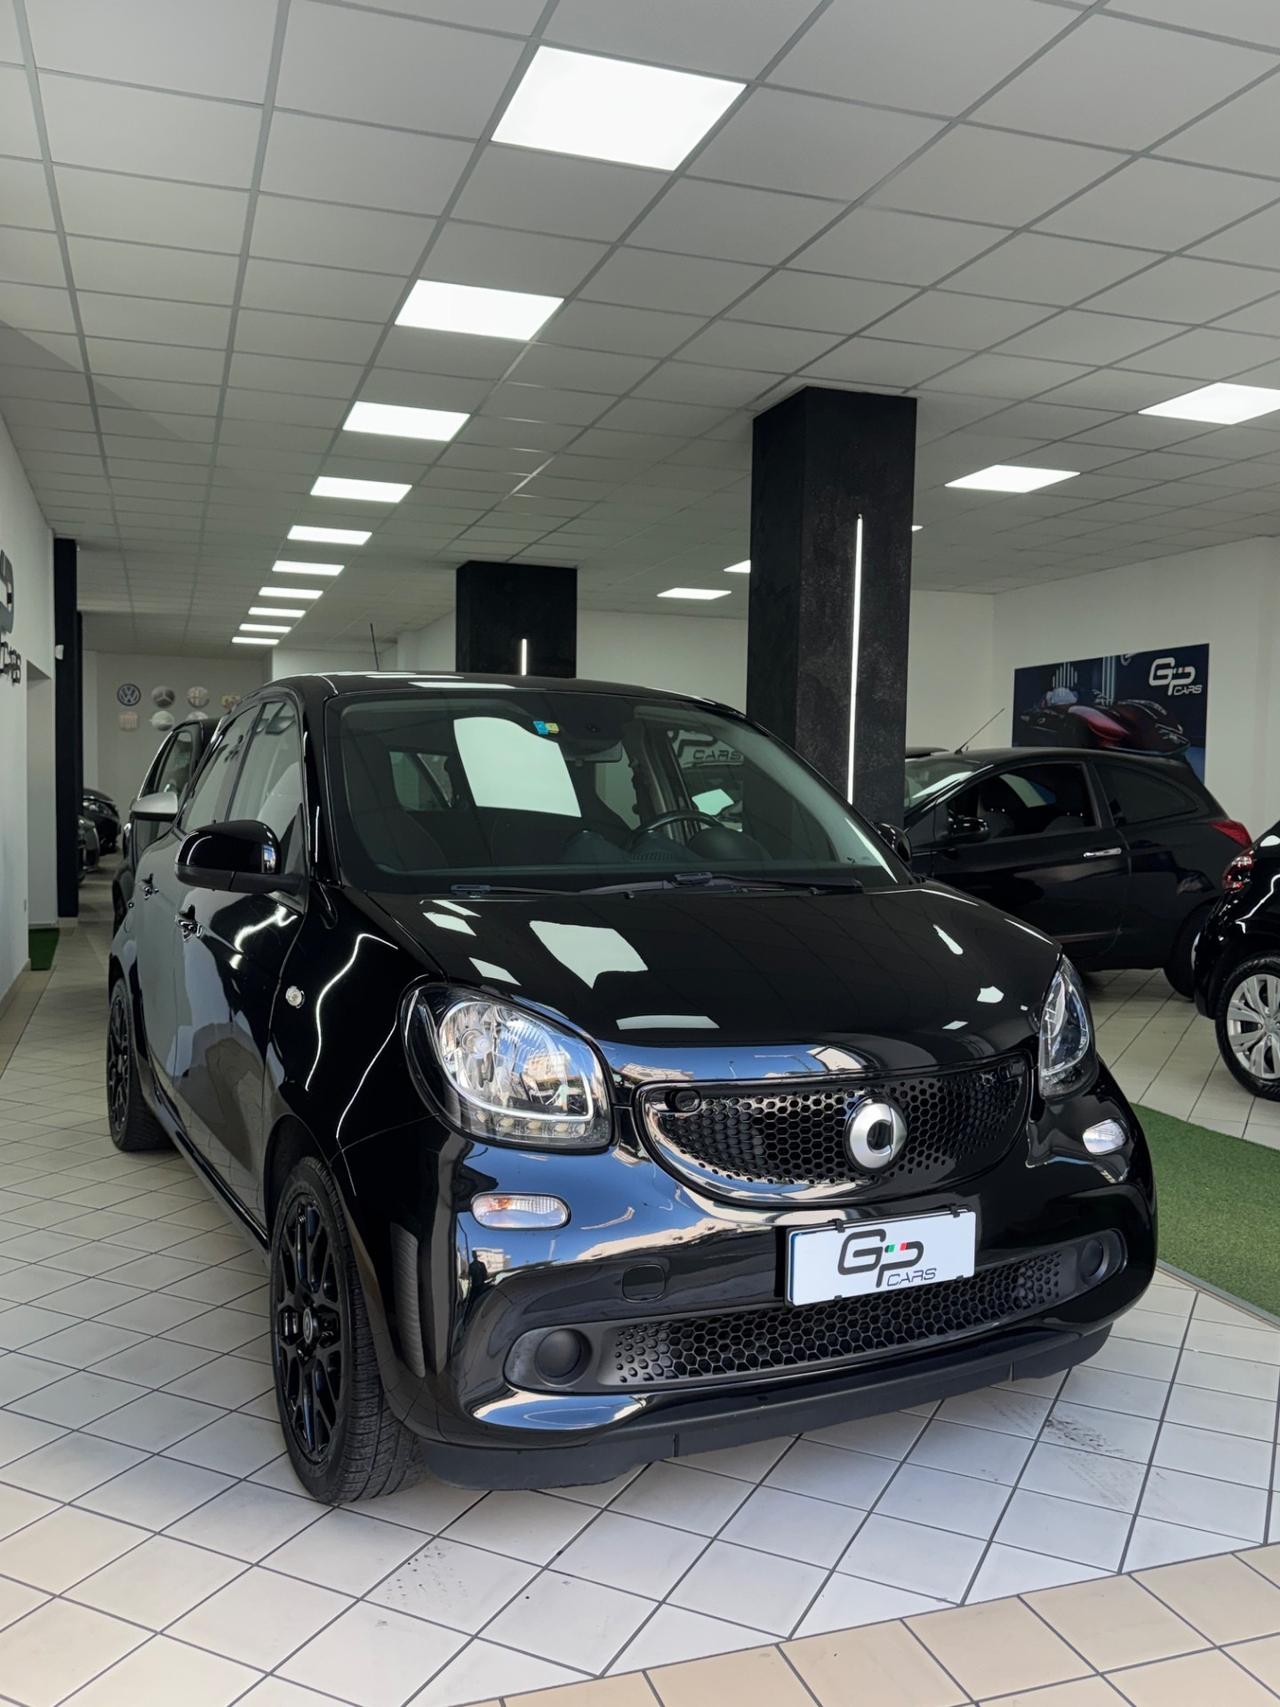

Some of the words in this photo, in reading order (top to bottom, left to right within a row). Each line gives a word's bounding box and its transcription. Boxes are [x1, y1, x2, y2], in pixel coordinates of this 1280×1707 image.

[1173, 684, 1202, 696] CARS
[693, 749, 742, 761] CARS
[837, 1228, 924, 1288] GP
[886, 1267, 937, 1287] CARS
